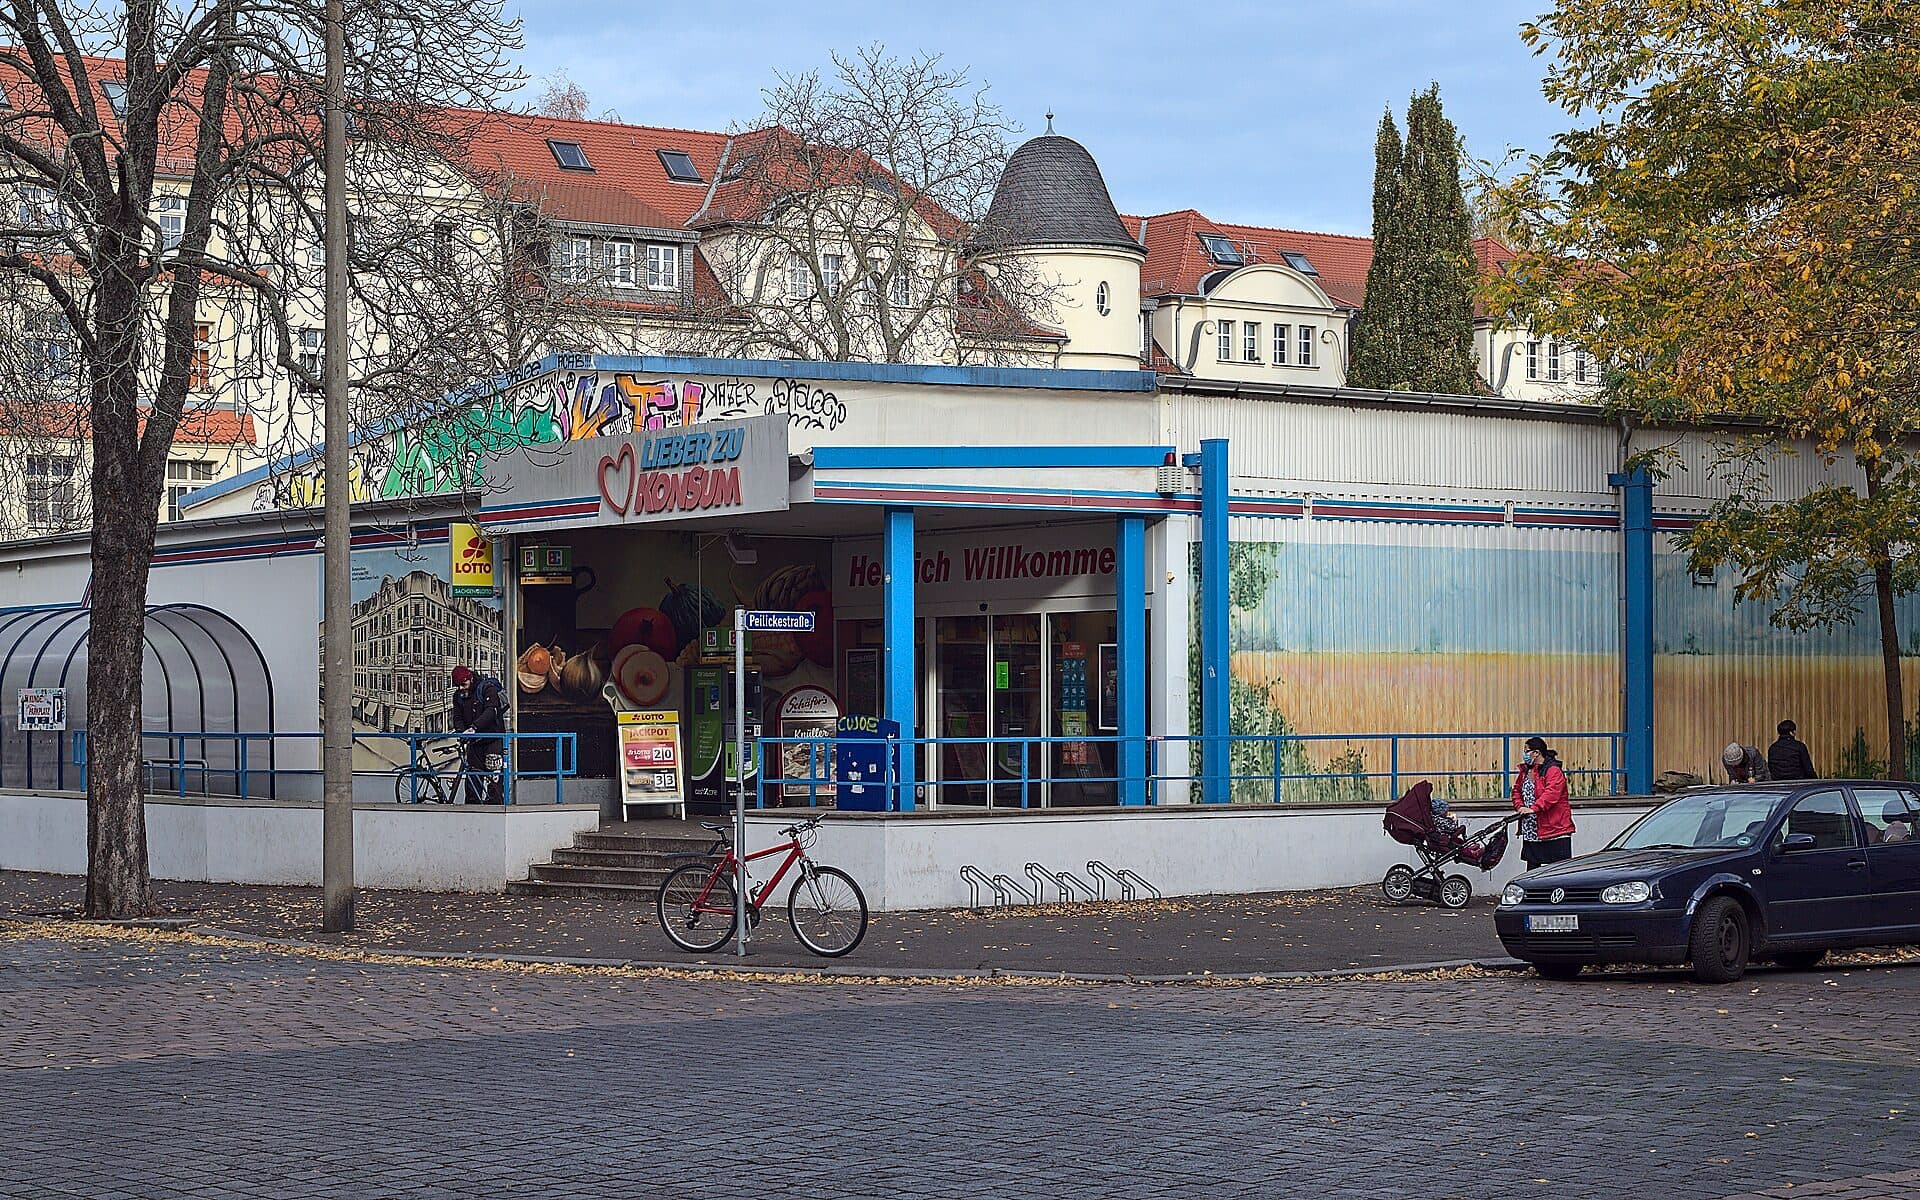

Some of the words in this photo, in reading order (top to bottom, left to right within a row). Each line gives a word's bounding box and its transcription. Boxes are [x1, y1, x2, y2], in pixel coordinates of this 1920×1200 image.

[641, 432, 712, 470] LIEBER
[712, 427, 744, 460] ZU
[634, 466, 743, 514] KONSUM
[455, 562, 492, 574] LOTTO
[849, 550, 951, 587] Heich
[963, 544, 1117, 581] Willkomme
[749, 614, 810, 628] Peilickestraße
[641, 713, 665, 721] LOTTO
[629, 727, 669, 738] JACKPOT
